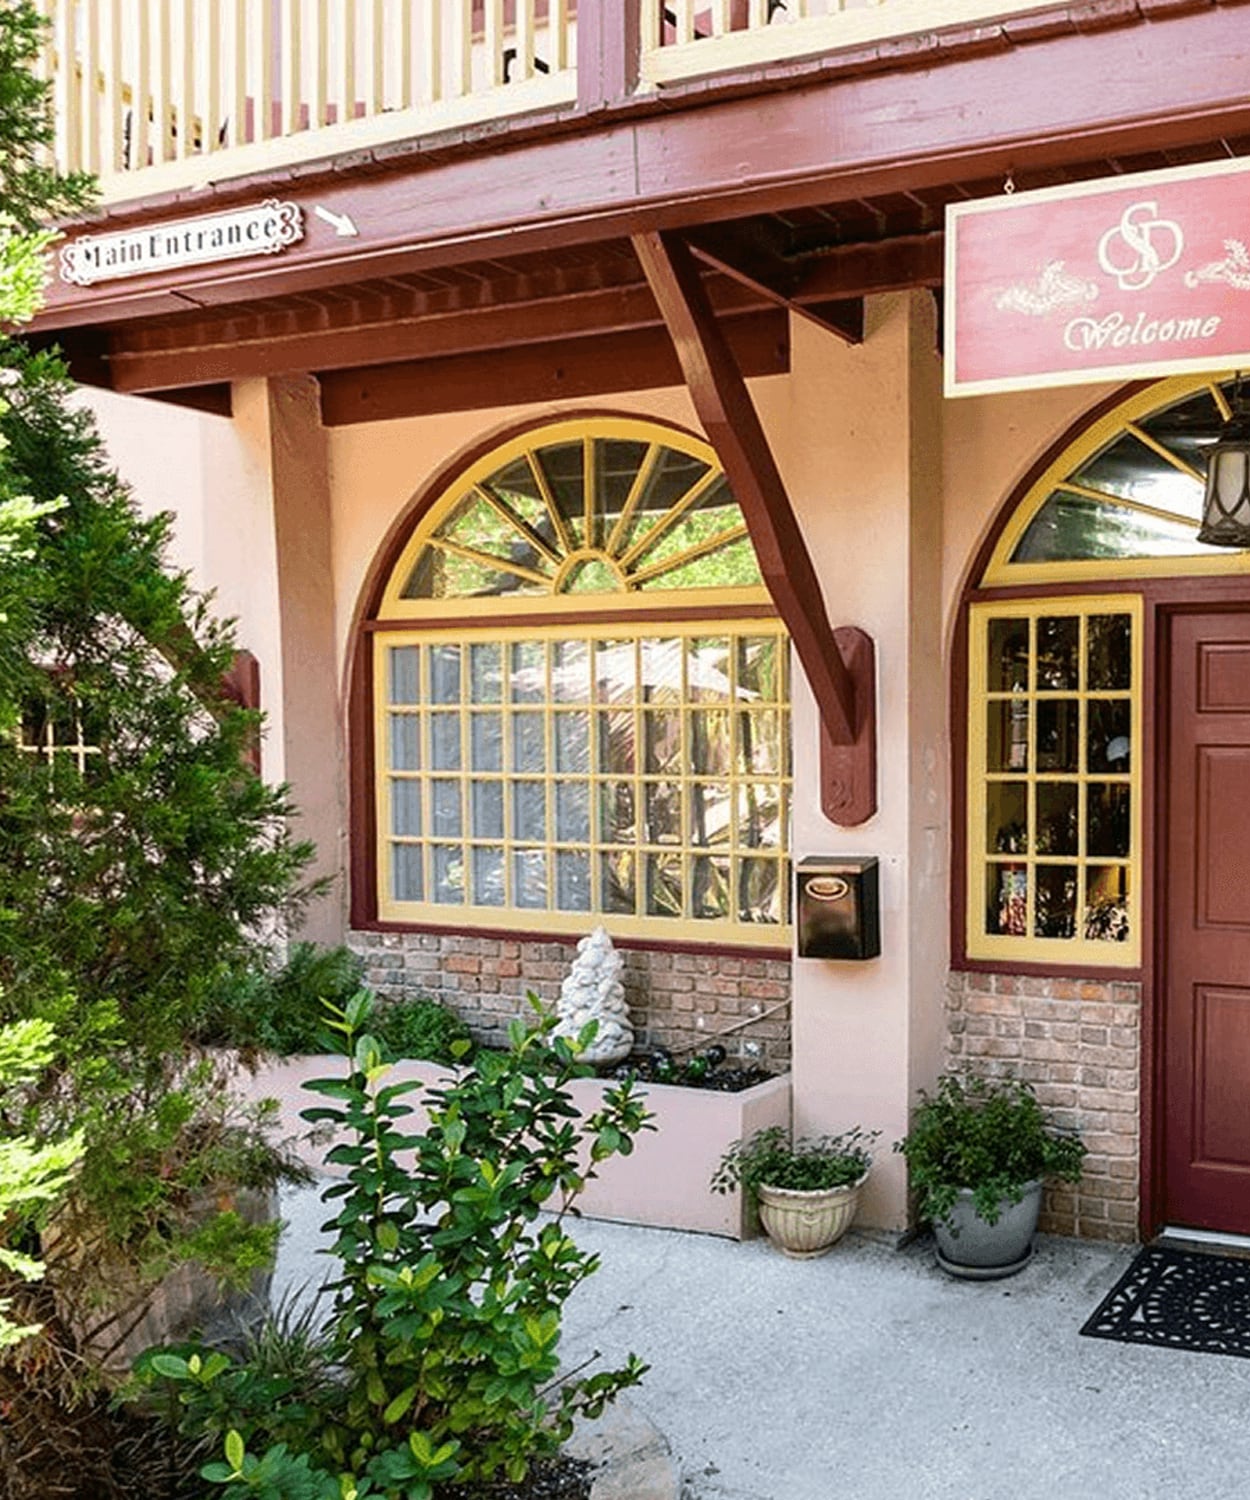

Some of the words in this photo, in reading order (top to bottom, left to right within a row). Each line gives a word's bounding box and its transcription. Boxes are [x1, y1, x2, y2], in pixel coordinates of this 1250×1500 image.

[83, 239, 142, 268] Main
[149, 215, 277, 258] Entrance
[1063, 311, 1222, 350] Welcome
